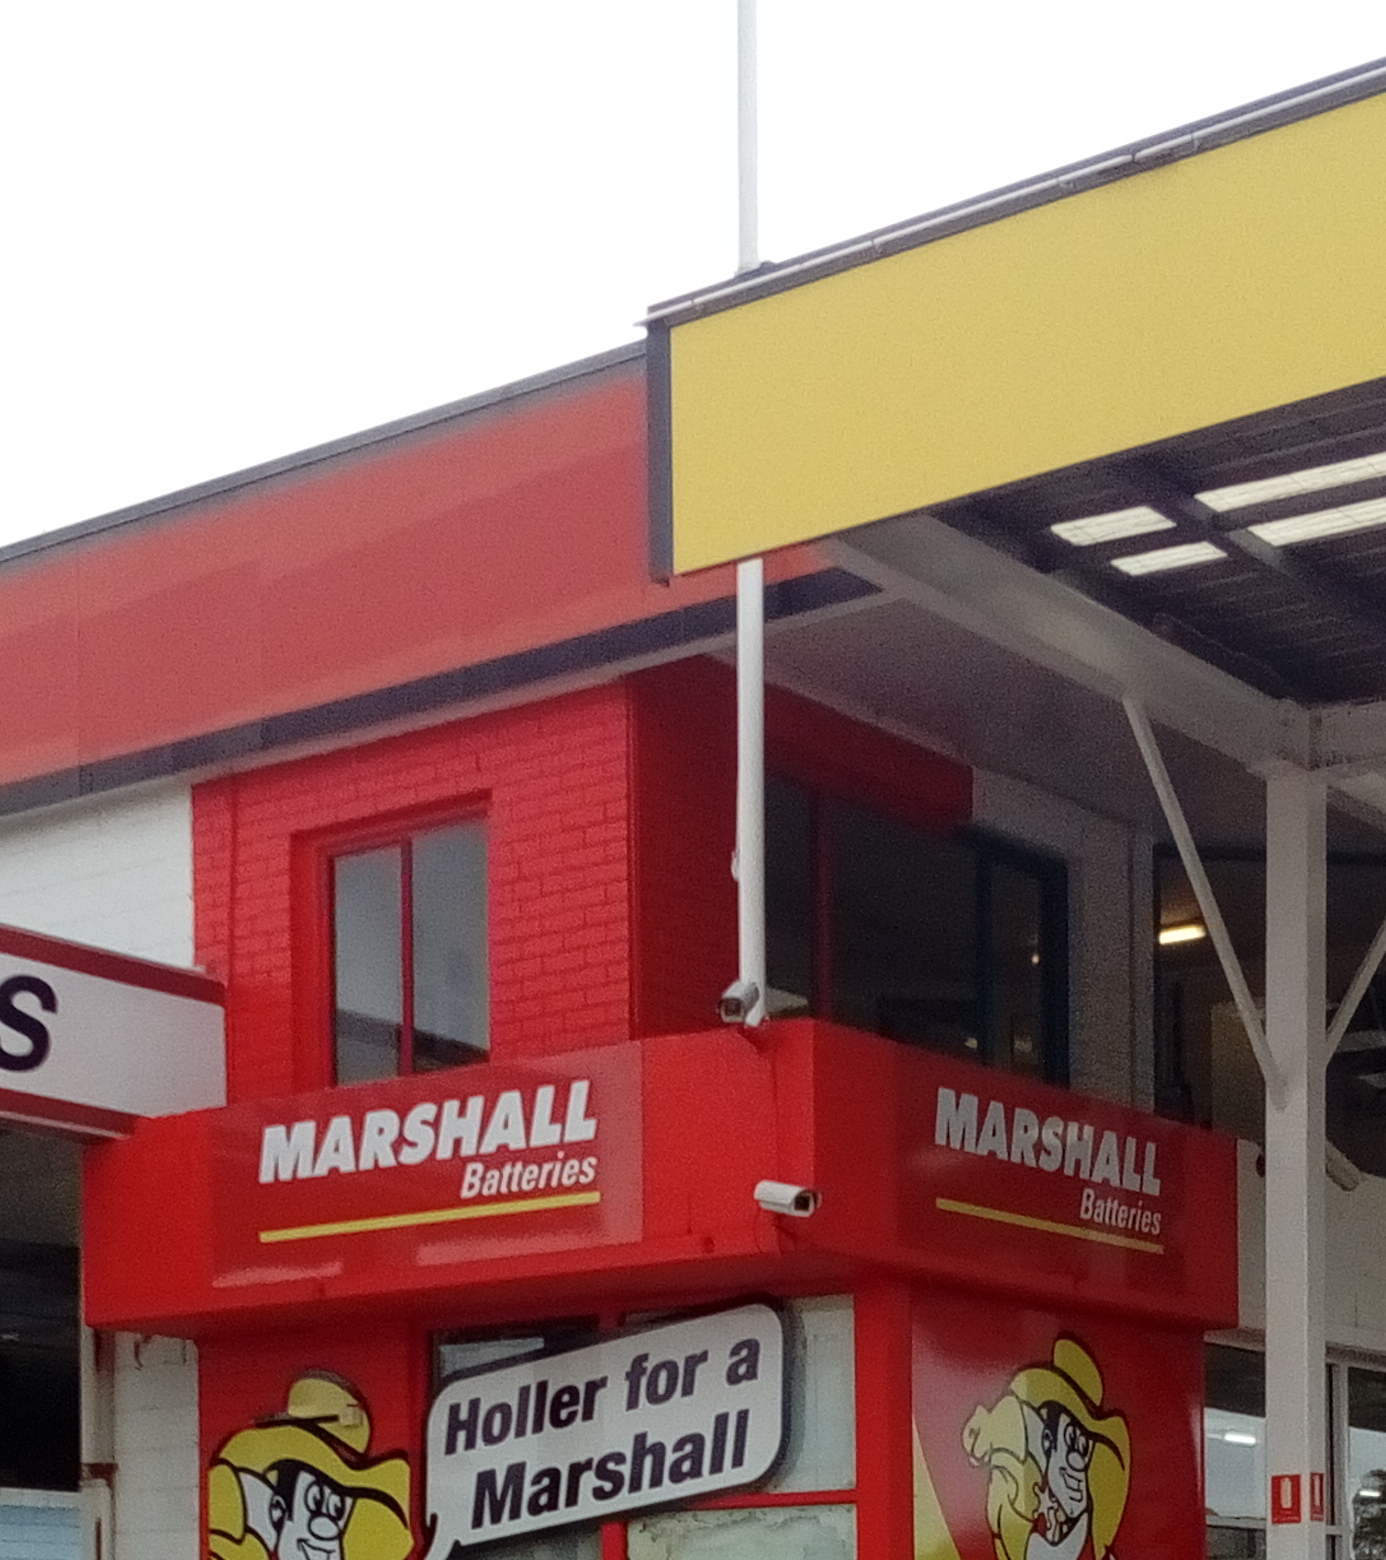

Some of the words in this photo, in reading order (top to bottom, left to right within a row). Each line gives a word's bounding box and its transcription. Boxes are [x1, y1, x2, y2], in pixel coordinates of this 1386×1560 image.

[258, 1080, 597, 1184] MARSHALL
[461, 1151, 597, 1200] Batteries
[935, 1086, 1161, 1197] MARSHALL
[1080, 1187, 1161, 1236] Batteries
[444, 1373, 607, 1455] Holler
[624, 1347, 709, 1412] for
[725, 1337, 761, 1385] a
[470, 1409, 749, 1530] Marshall
